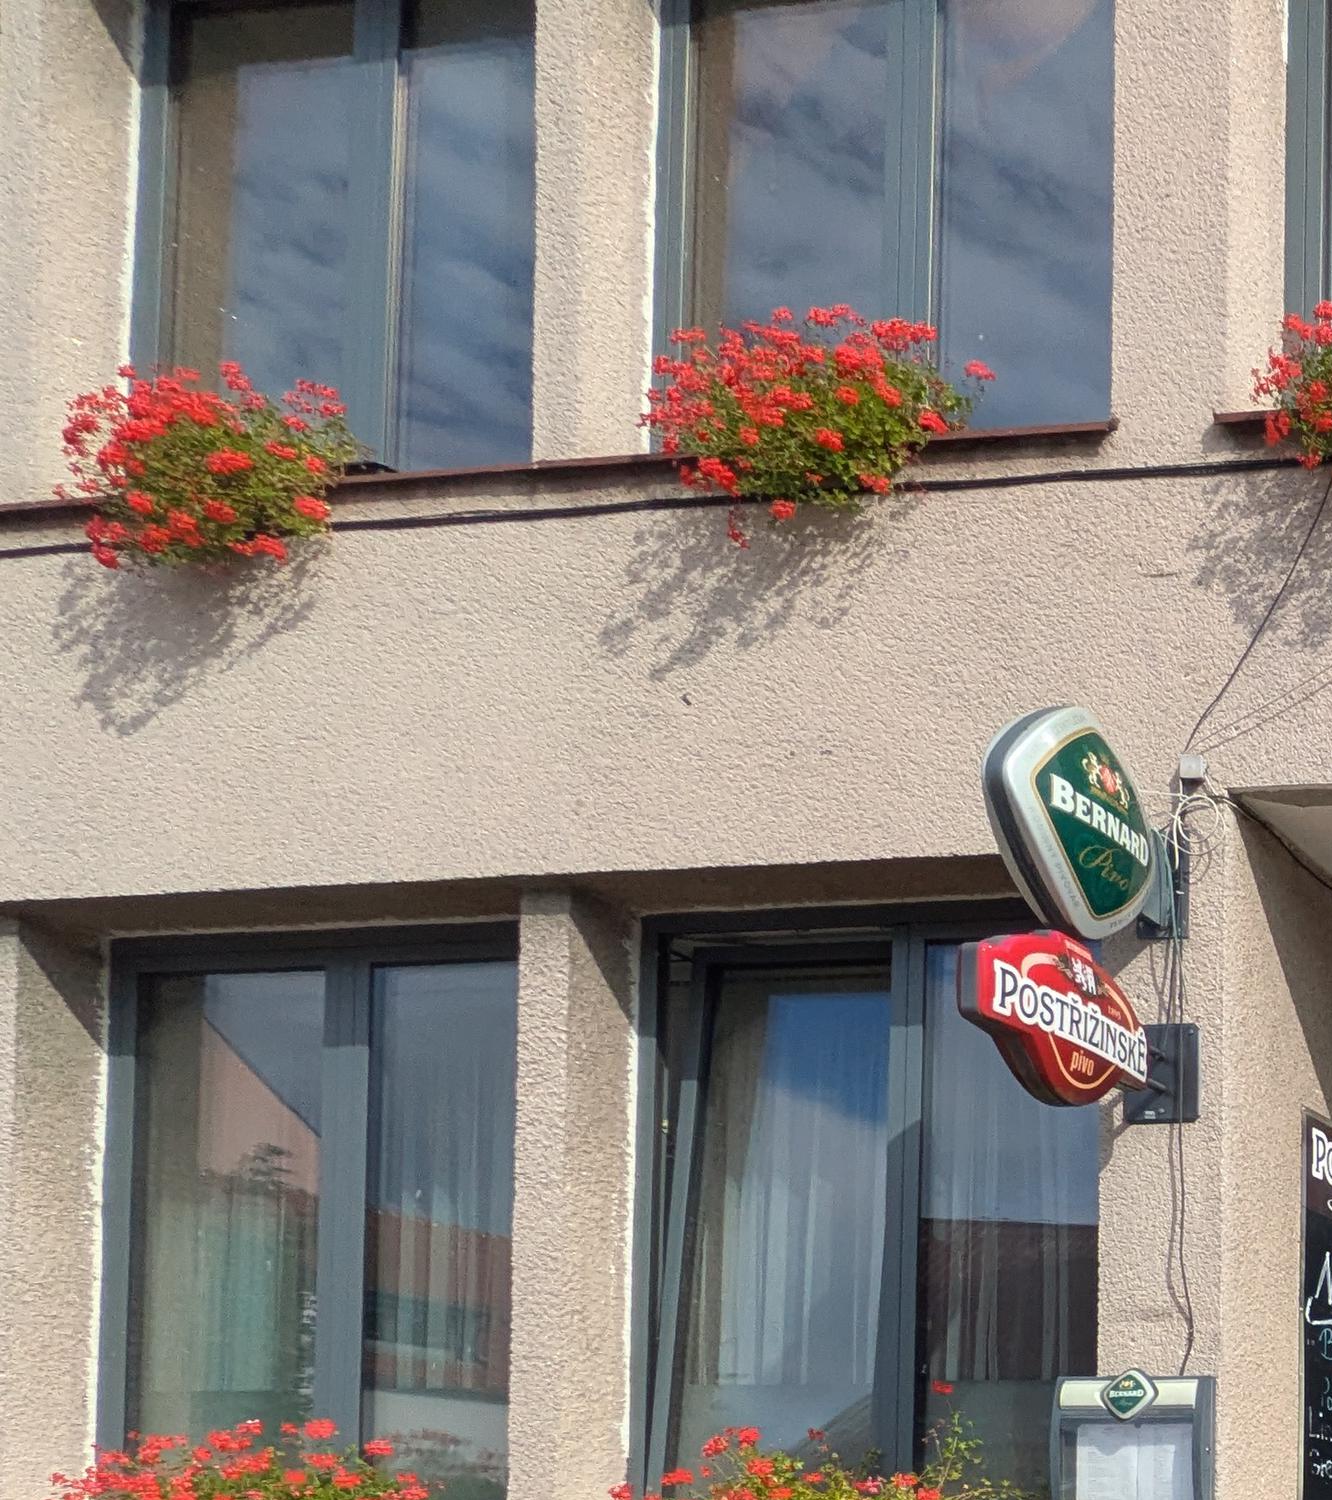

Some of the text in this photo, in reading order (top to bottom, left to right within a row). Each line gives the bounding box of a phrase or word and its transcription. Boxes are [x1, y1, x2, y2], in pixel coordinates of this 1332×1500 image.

[1049, 773, 1149, 867] BERNARD
[996, 962, 1147, 1078] POSTŘIŽINSKÉ
[1070, 1050, 1094, 1077] pivo
